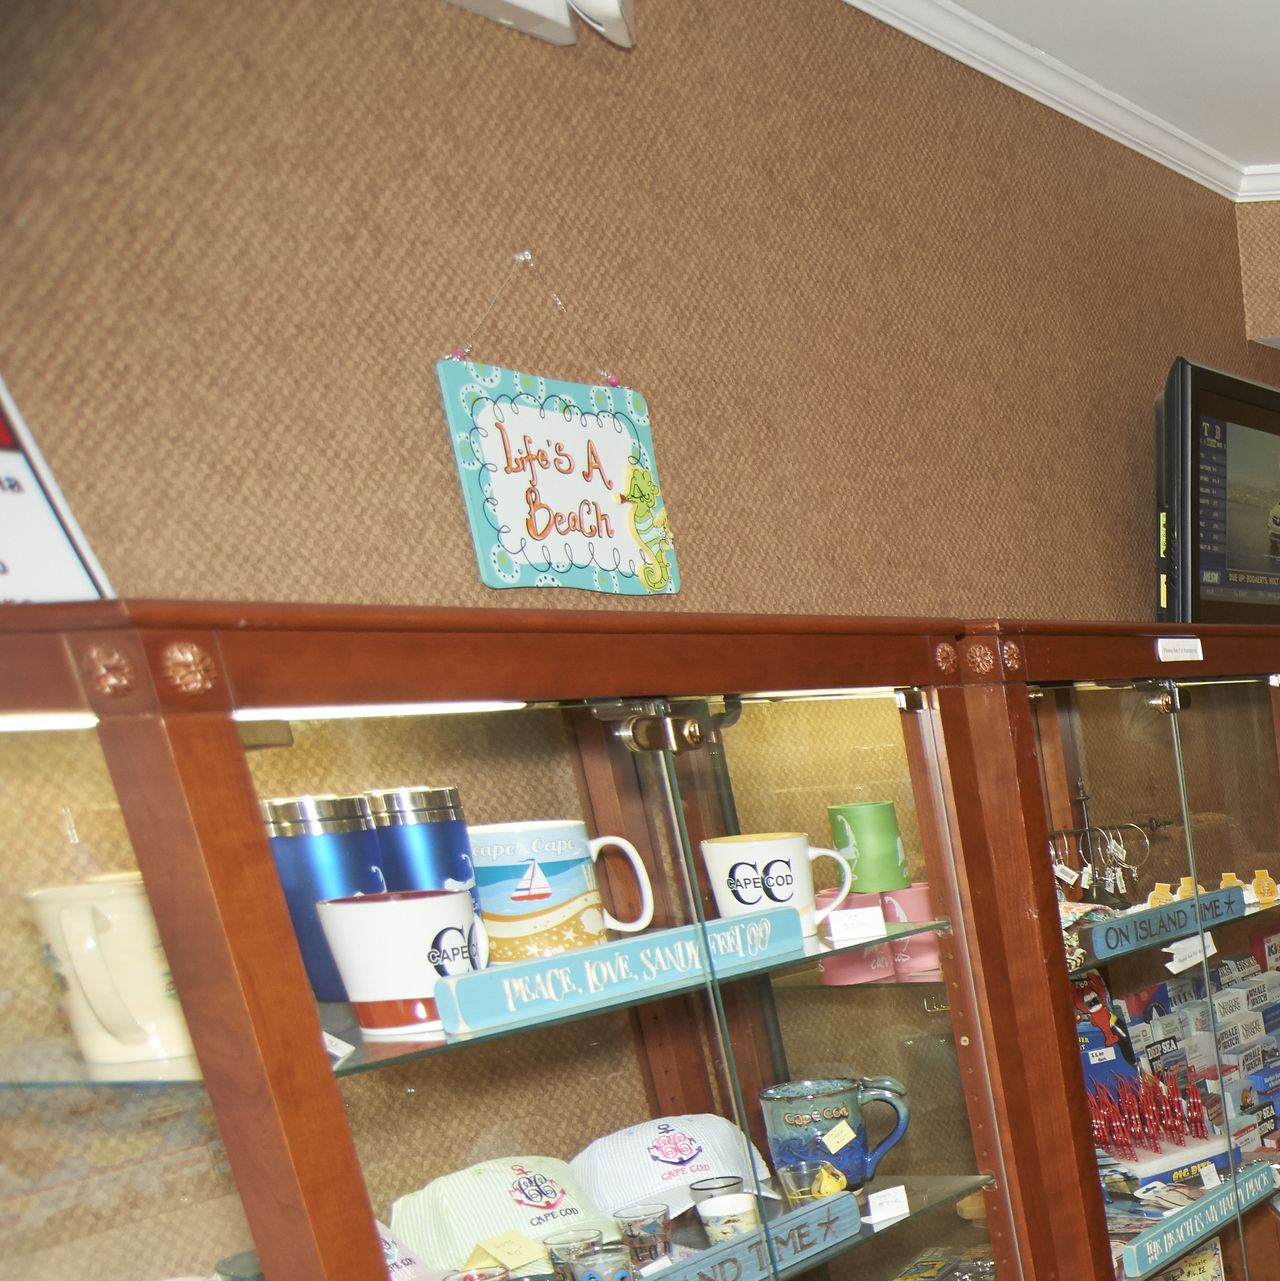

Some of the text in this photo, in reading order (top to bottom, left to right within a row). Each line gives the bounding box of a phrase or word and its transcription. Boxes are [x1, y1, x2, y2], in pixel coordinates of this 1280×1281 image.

[582, 439, 613, 490] A
[726, 873, 794, 890] CAPE COD
[1104, 898, 1224, 951] ON ISLAND TIME
[427, 944, 469, 965] CAPE
[502, 966, 583, 1013] PEACE,
[583, 950, 639, 997] LOVE,
[640, 938, 703, 981] SANDY
[1161, 1039, 1177, 1054] SEA
[660, 1163, 712, 1182] CAPE COD
[529, 1206, 579, 1228] CAPE COD
[1144, 1238, 1163, 1265] THE
[1163, 1218, 1195, 1254] BEACH
[1194, 1212, 1205, 1233] IS
[1204, 1205, 1219, 1225] MY
[748, 1222, 818, 1273] TME
